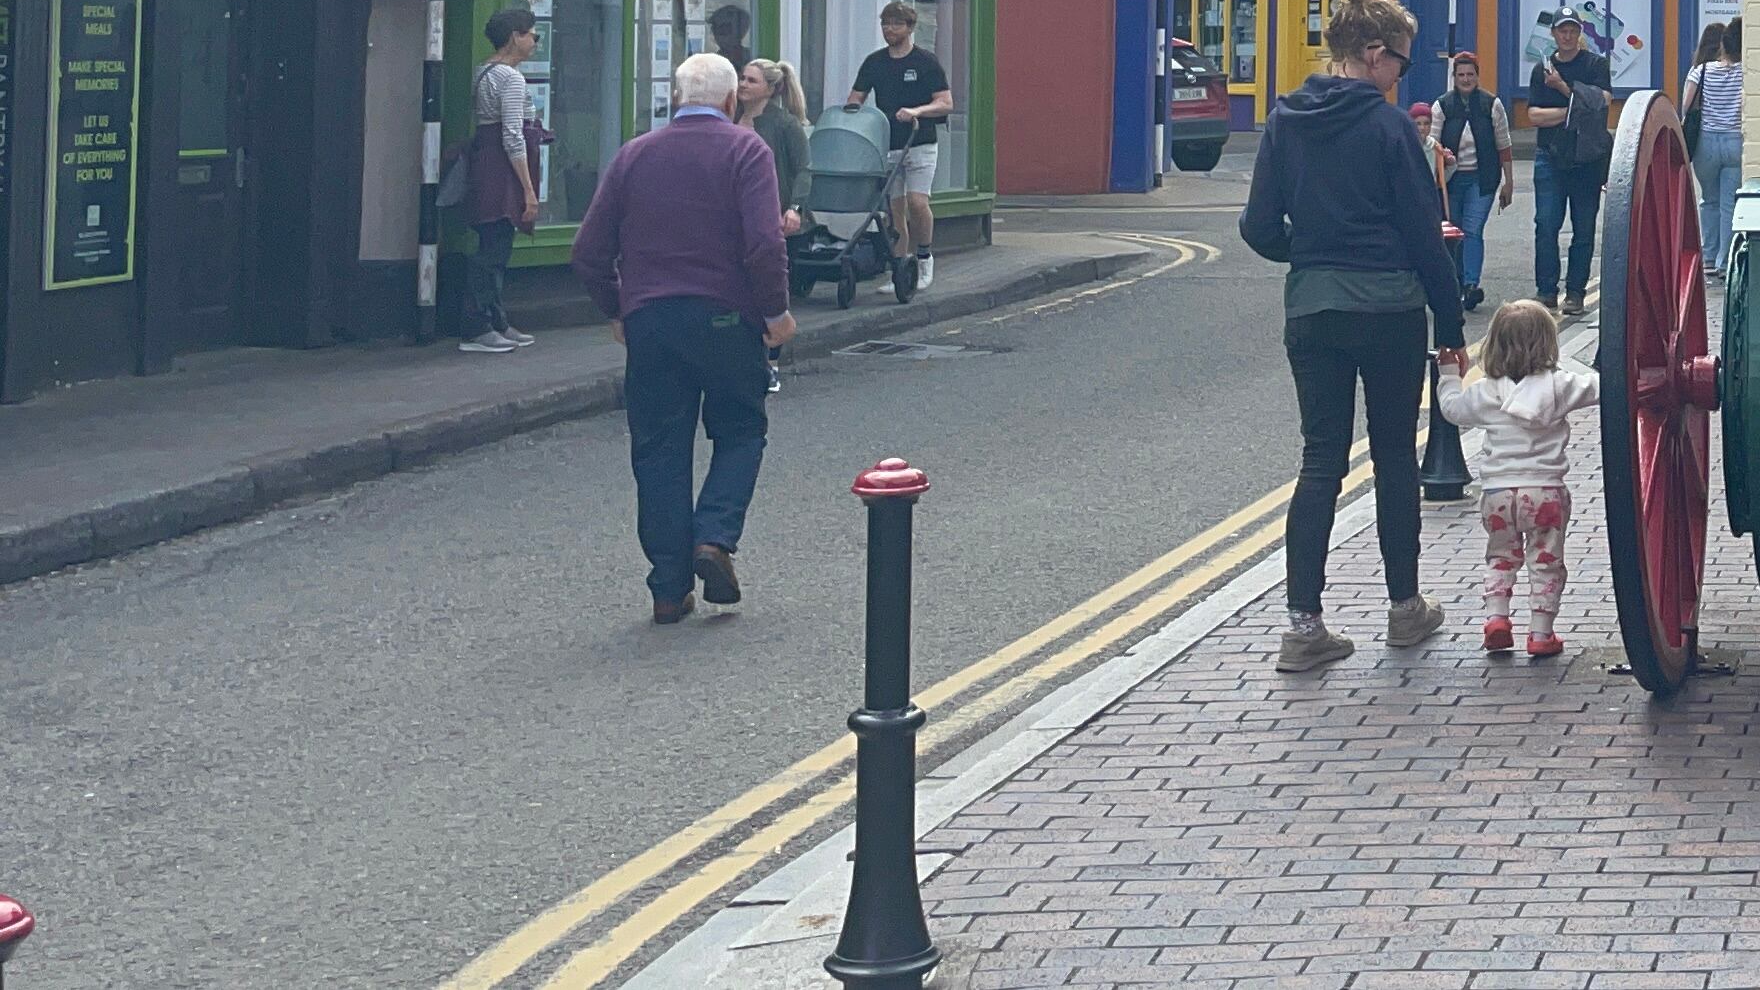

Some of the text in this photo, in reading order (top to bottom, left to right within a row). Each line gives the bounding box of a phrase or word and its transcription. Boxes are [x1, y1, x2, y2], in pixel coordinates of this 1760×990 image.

[84, 115, 97, 128] LET
[63, 149, 126, 164] OF EVERYTHING
[77, 167, 113, 182] FOR YOU
